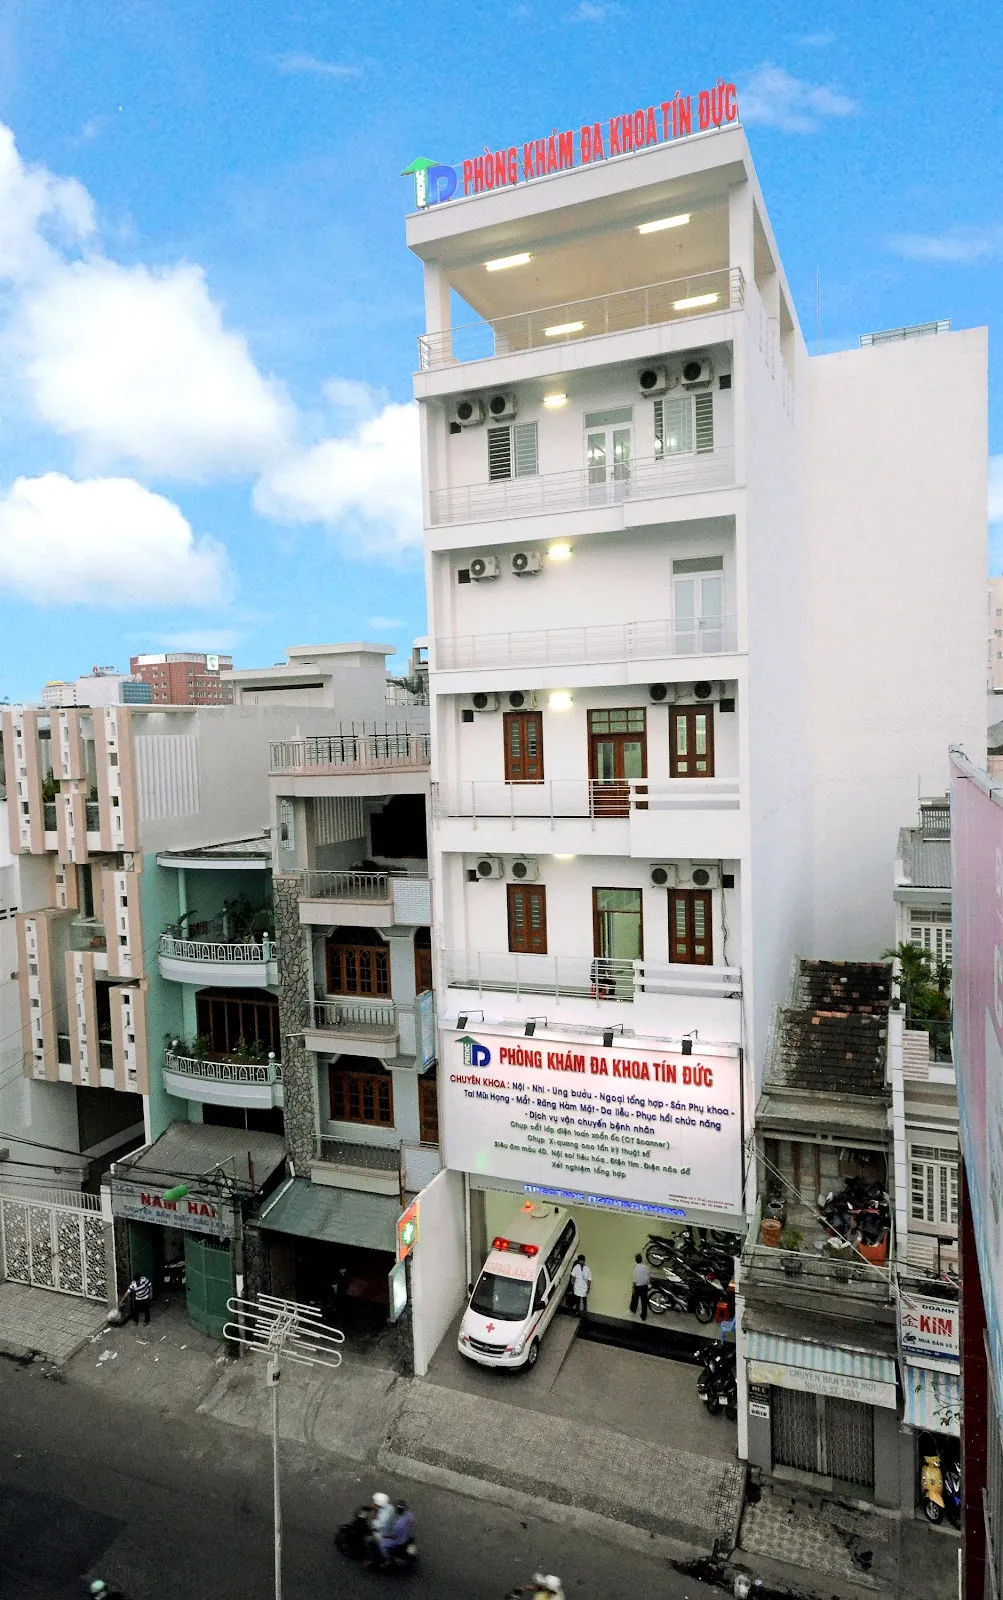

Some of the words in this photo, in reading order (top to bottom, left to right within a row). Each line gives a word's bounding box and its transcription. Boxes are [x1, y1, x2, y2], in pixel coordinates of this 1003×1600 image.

[463, 147, 518, 195] PHÒNG
[523, 128, 575, 178] KHÁM
[580, 122, 603, 164] ĐA
[608, 107, 659, 155] KHOA
[660, 90, 692, 140] TÍN
[698, 77, 737, 130] ĐỨC
[499, 1044, 542, 1069] PHÒNG
[547, 1051, 585, 1074] KHÁM
[590, 1056, 609, 1076] ĐA
[613, 1059, 650, 1082] KHOA
[653, 1060, 677, 1084] TÍN
[682, 1063, 714, 1088] ĐỨC
[450, 1074, 480, 1086] CHUYÊN
[512, 1082, 525, 1091] Nội
[532, 1084, 545, 1093] Nhi
[599, 1092, 625, 1105] Ngoại
[627, 1094, 645, 1107] tổng
[648, 1097, 664, 1109] hợp
[671, 1100, 686, 1111] Sản
[688, 1102, 704, 1113] Phụ
[707, 1105, 729, 1116] khoa
[464, 1089, 475, 1098] Tai
[476, 1091, 489, 1100] Mũi
[490, 1094, 510, 1104] Họng
[516, 1094, 530, 1105] Mắt
[537, 1098, 557, 1110] Răng
[559, 1099, 577, 1111] Hàm
[580, 1103, 595, 1114] Mặt
[600, 1107, 612, 1115] Da
[615, 1107, 629, 1117] liễu
[636, 1110, 657, 1121] Phục
[660, 1113, 673, 1123] hồi
[675, 1115, 697, 1126] chức
[699, 1120, 721, 1131] năng
[510, 1121, 528, 1130] Chụp
[621, 1136, 635, 1144] (CT
[529, 1111, 546, 1120] Dịch
[549, 1115, 559, 1123] vụ
[560, 1116, 575, 1125] vận
[577, 1118, 607, 1129] chuyển
[610, 1121, 631, 1132] bệnh
[634, 1124, 655, 1135] nhân
[527, 1134, 545, 1144] Chụp
[549, 1138, 579, 1150] X-quang
[621, 1147, 640, 1157] thuật
[521, 1145, 536, 1154] màu
[551, 1150, 563, 1159] Nội
[610, 1157, 626, 1167] Điện
[628, 1160, 639, 1168] tim
[644, 1163, 660, 1172] Điện
[565, 1164, 591, 1174] nghiệm
[593, 1167, 609, 1177] tổng
[612, 1169, 626, 1179] hợp
[922, 1304, 955, 1314] DOANH
